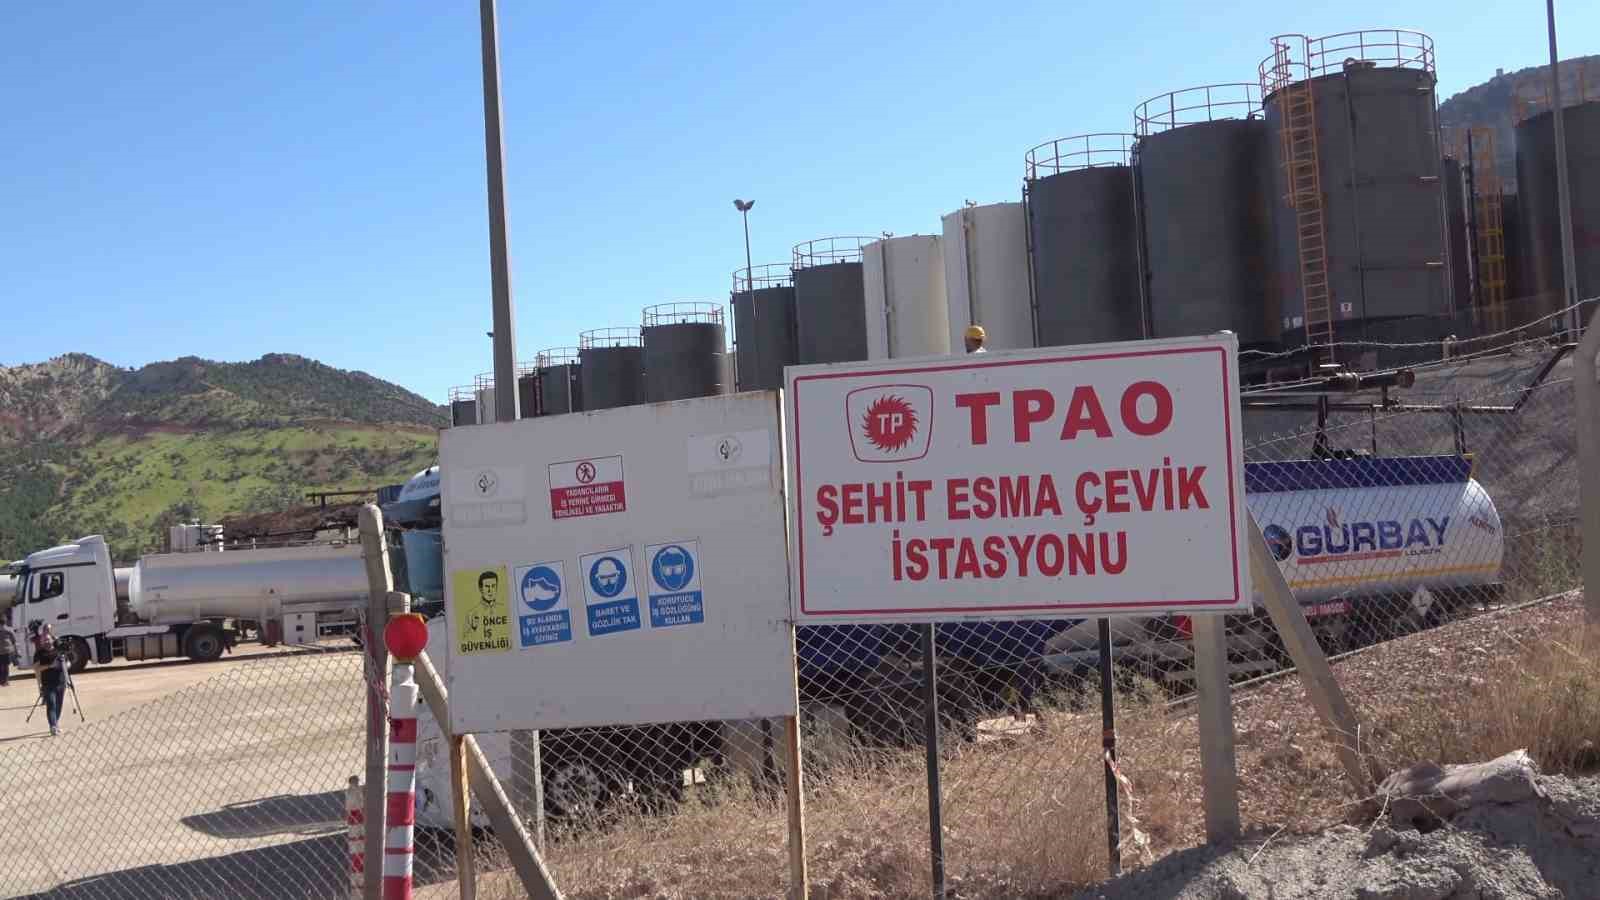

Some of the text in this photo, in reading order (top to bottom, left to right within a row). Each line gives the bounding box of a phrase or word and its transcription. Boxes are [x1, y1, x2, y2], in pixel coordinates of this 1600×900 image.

[956, 381, 1173, 445] TPAO
[877, 413, 903, 435] TP
[817, 471, 933, 536] ŞEHİT
[946, 475, 1062, 521] ESMA
[1075, 457, 1209, 526] ÇEVİK
[892, 529, 1128, 581] İSTASYONU
[483, 615, 507, 626] ÖNCE
[622, 615, 637, 625] TAK
[665, 616, 691, 625] KULLAN
[484, 628, 493, 640] İŞ
[461, 637, 509, 653] GÜVENLİĞİ
